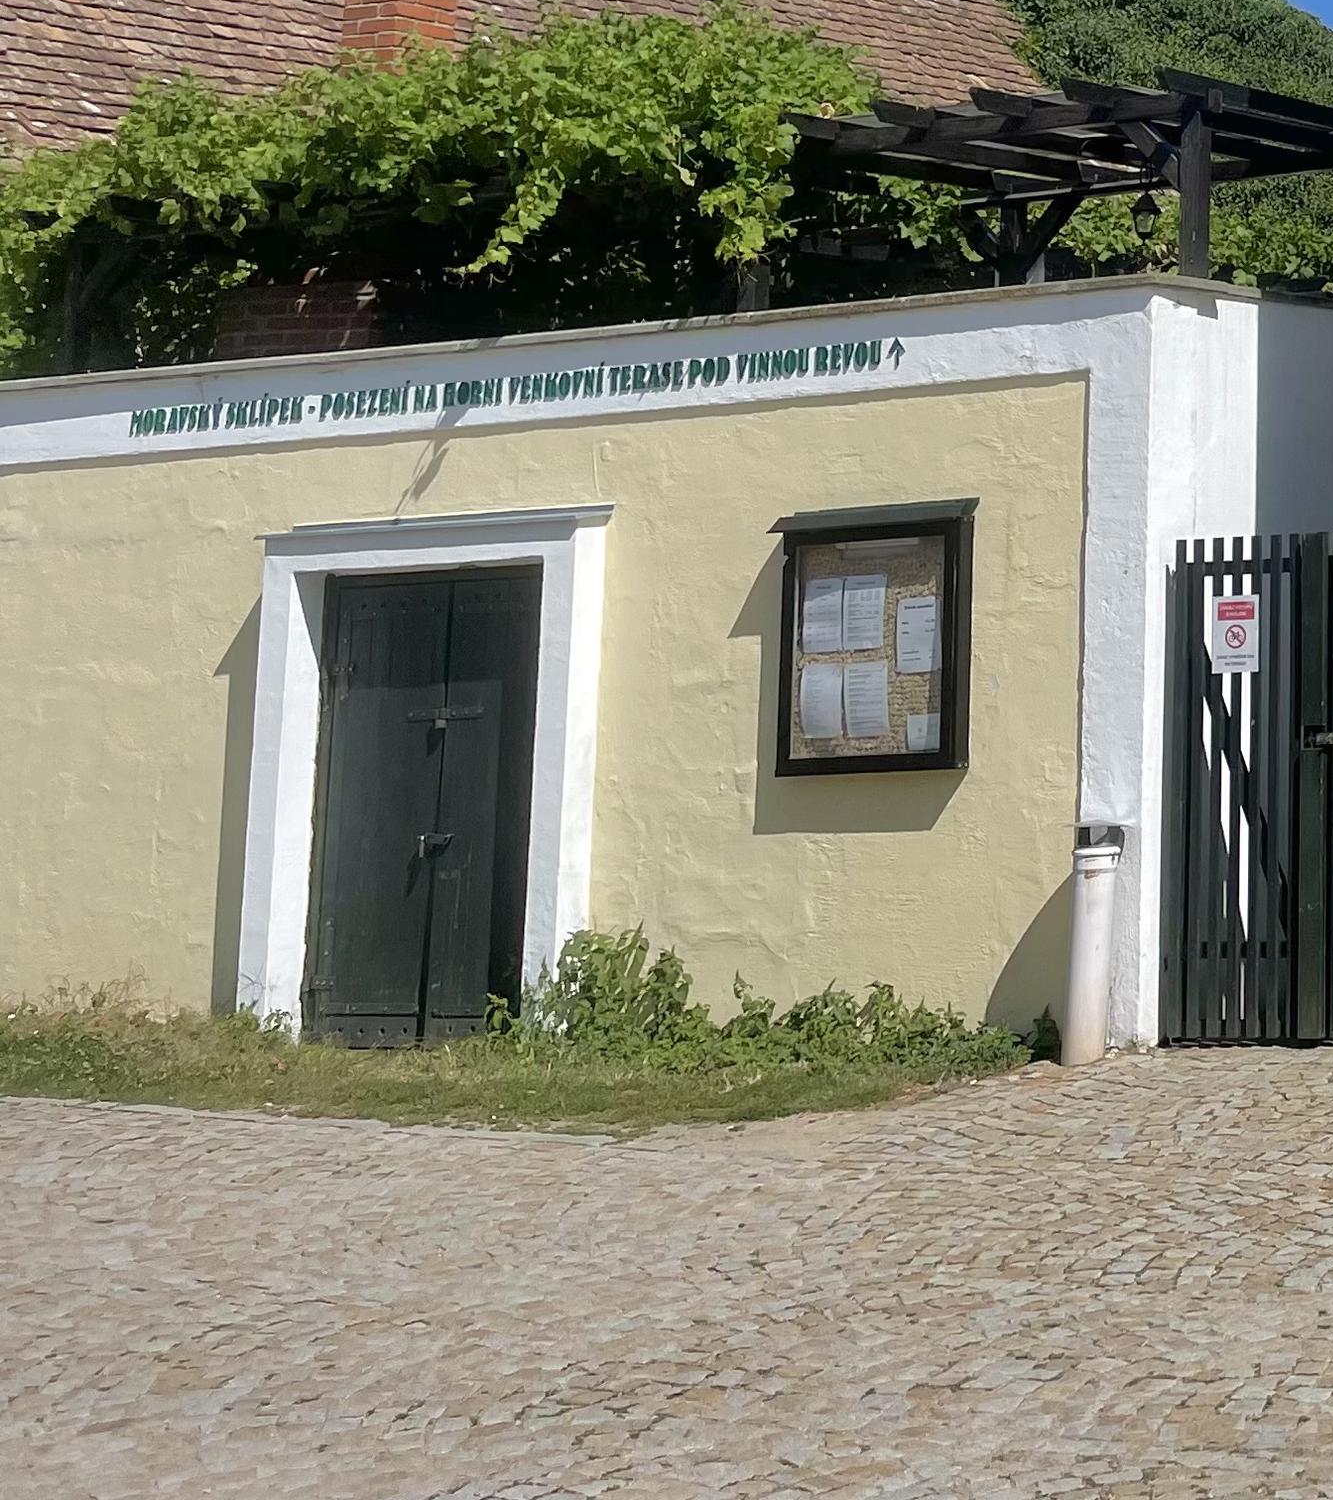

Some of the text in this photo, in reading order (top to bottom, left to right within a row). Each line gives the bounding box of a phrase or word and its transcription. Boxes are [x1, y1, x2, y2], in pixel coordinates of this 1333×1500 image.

[128, 396, 223, 437] MORAVSKÝ
[225, 392, 304, 429] SKLÍPEK
[318, 380, 410, 422] POSEZENÍ
[413, 385, 437, 412] NA
[508, 361, 604, 405] VENKOVNÍ
[609, 361, 684, 396] TERASE
[686, 357, 731, 388] POD
[736, 349, 809, 384] VINNOU
